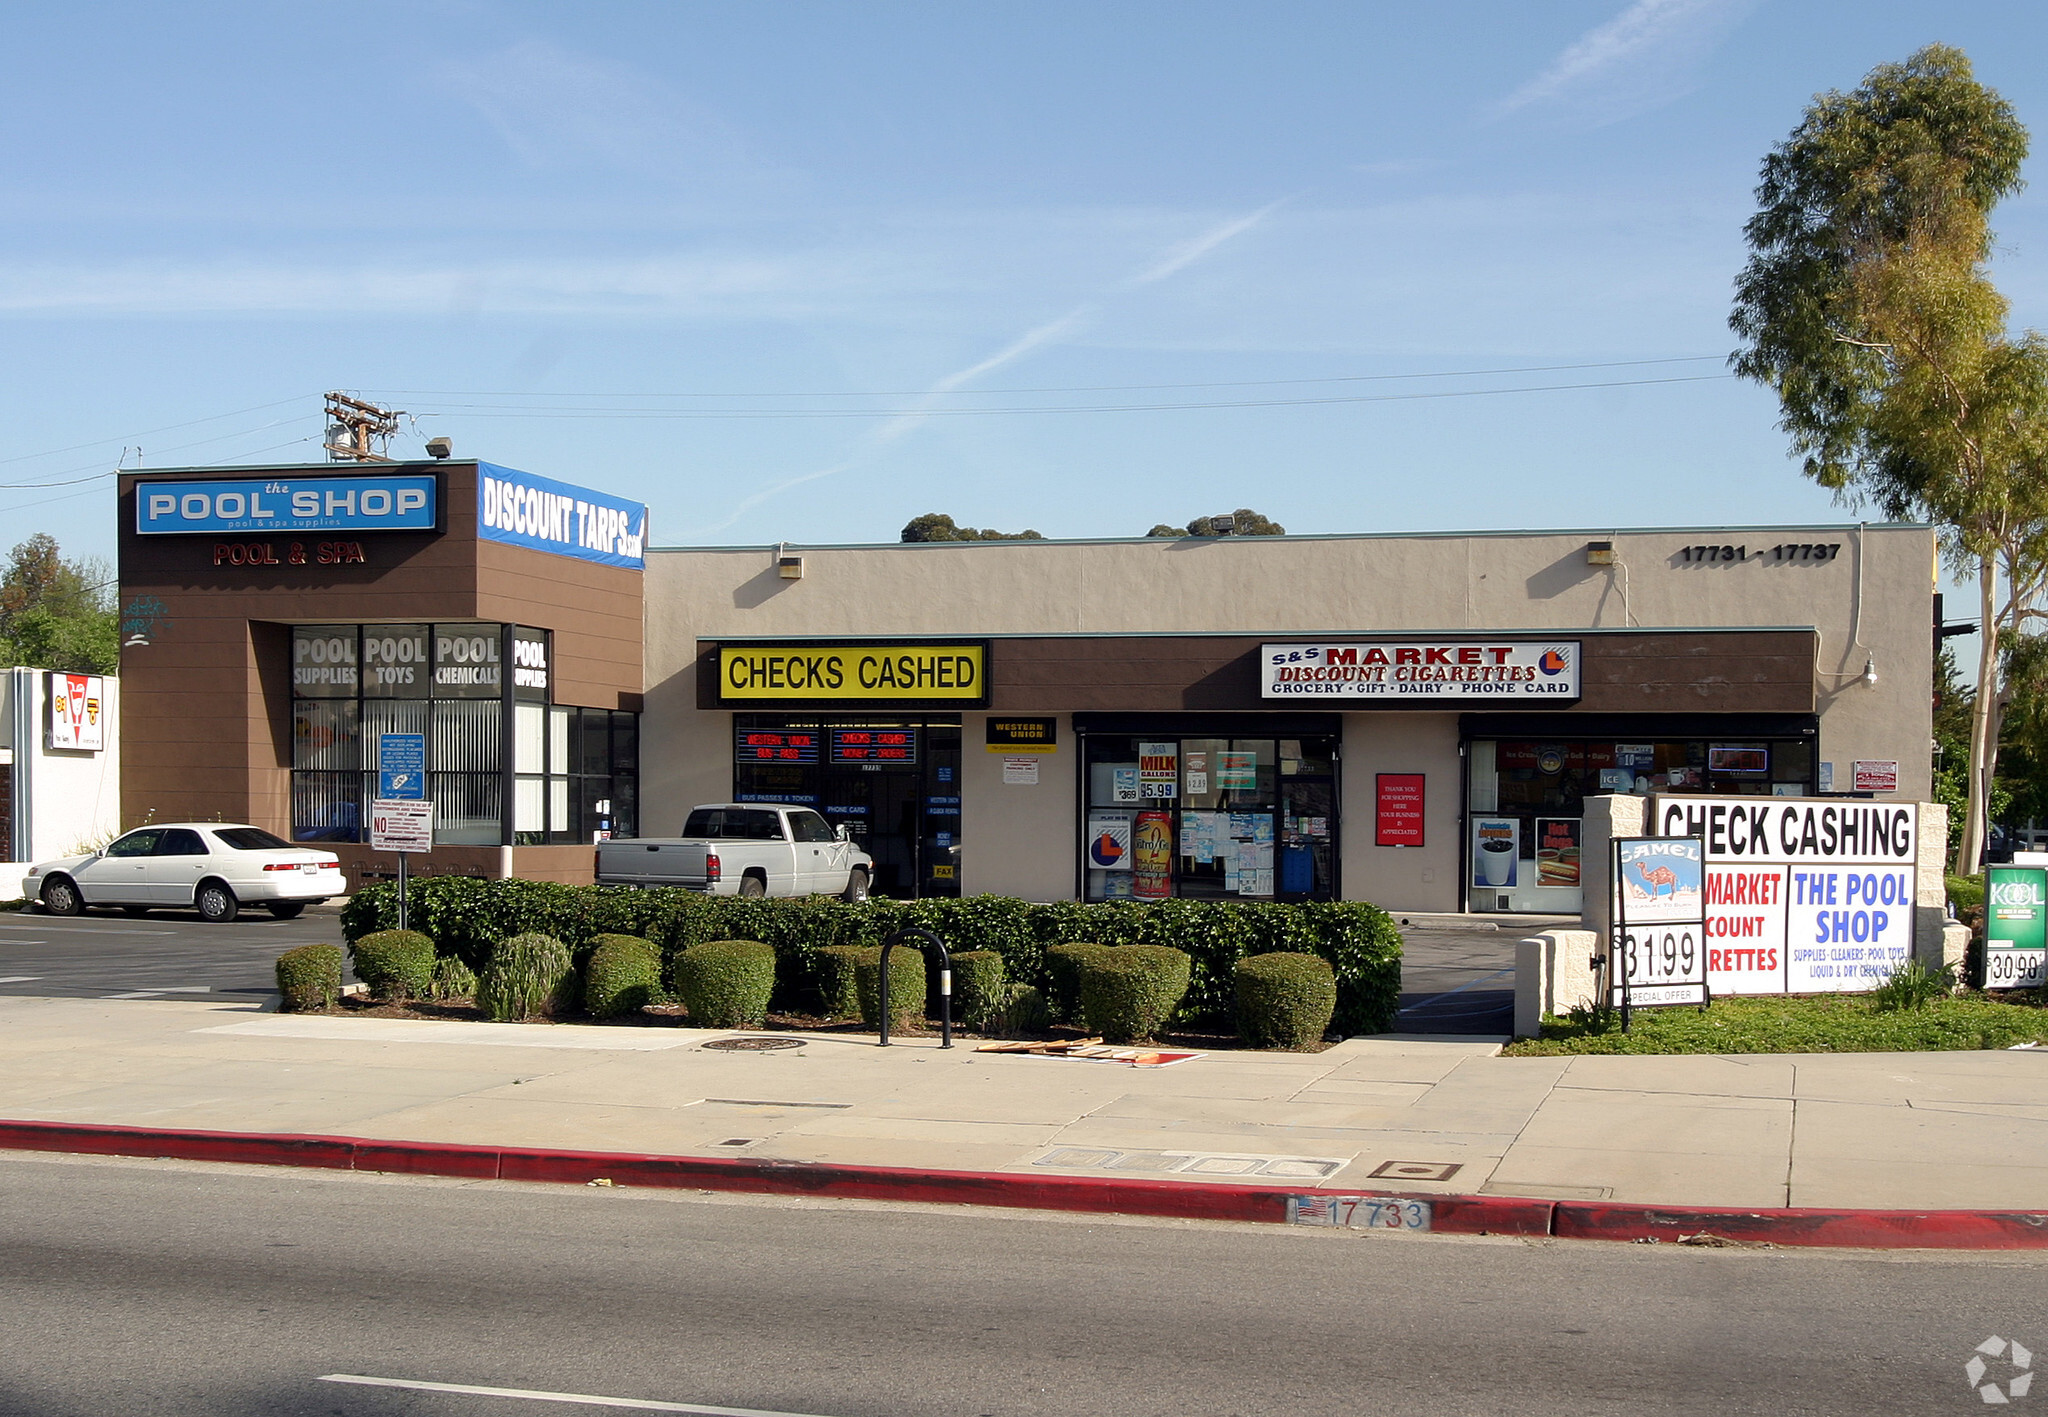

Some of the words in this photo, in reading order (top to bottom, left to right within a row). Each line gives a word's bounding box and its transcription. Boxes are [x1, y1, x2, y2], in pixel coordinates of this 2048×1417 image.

[264, 482, 290, 494] the
[149, 493, 275, 520] POOL
[291, 488, 427, 518] SHOP
[484, 476, 574, 544] DISCOUNT
[228, 519, 252, 530] pool
[258, 519, 264, 528] &
[269, 520, 288, 528] spa
[292, 517, 341, 528] supplies
[214, 544, 280, 566] POOL
[288, 542, 307, 564] &
[317, 542, 366, 563] SPA
[1682, 546, 1746, 561] 17731
[1773, 544, 1841, 560] 17737
[296, 638, 356, 663] POOL
[365, 638, 426, 662] POOL
[437, 638, 498, 662] POOL
[514, 640, 546, 668] POOL
[1272, 648, 1319, 665] S&S
[1326, 648, 1513, 665] MARKET
[294, 668, 358, 684] SUPPLIES
[376, 667, 414, 684] TOYS
[436, 667, 500, 684] CHEMICALS
[514, 668, 546, 688] UPPLIES
[729, 656, 844, 689] CHECKS
[858, 656, 974, 689] CASHED
[1279, 667, 1386, 682] DISCOUNT
[1394, 666, 1536, 682] CIGARETTES
[1272, 684, 1344, 693] GROCERY
[1357, 684, 1386, 693] GIFT
[1398, 684, 1443, 693] DAIRY
[1462, 683, 1516, 693] PHONE
[1525, 683, 1570, 693] CARD
[746, 734, 782, 746] WESTERN
[788, 735, 812, 746] UNION
[841, 733, 871, 744] CHECKS
[877, 734, 907, 744] CASHED
[756, 748, 774, 758] BUS
[778, 748, 800, 759] PASS
[842, 748, 870, 758] MONEY
[876, 748, 906, 758] ORDERS
[1624, 754, 1634, 766] 10
[1141, 756, 1176, 770] MILK
[1603, 776, 1619, 784] ICE
[374, 817, 387, 833] NO
[1548, 823, 1569, 835] Hot
[1664, 804, 1770, 855] CHECK
[1780, 806, 1910, 857] CASHING
[1544, 835, 1574, 849] Dogs
[1621, 843, 1699, 863] CAMEL
[1706, 873, 1781, 905] MARKET
[1795, 874, 1838, 905] THE
[1846, 874, 1908, 906] POOL
[1990, 882, 2045, 906] KOOL
[1816, 910, 1888, 944] SHOP
[1708, 948, 1778, 971] RETTES
[1868, 948, 1886, 960] POOL
[1810, 965, 1833, 978] LIQUID
[1836, 966, 1842, 977] &
[1844, 965, 1858, 978] DRY
[1628, 990, 1661, 1002] PECIAL
[1664, 990, 1692, 1000] OFFER
[1328, 1202, 1422, 1228] 17733
